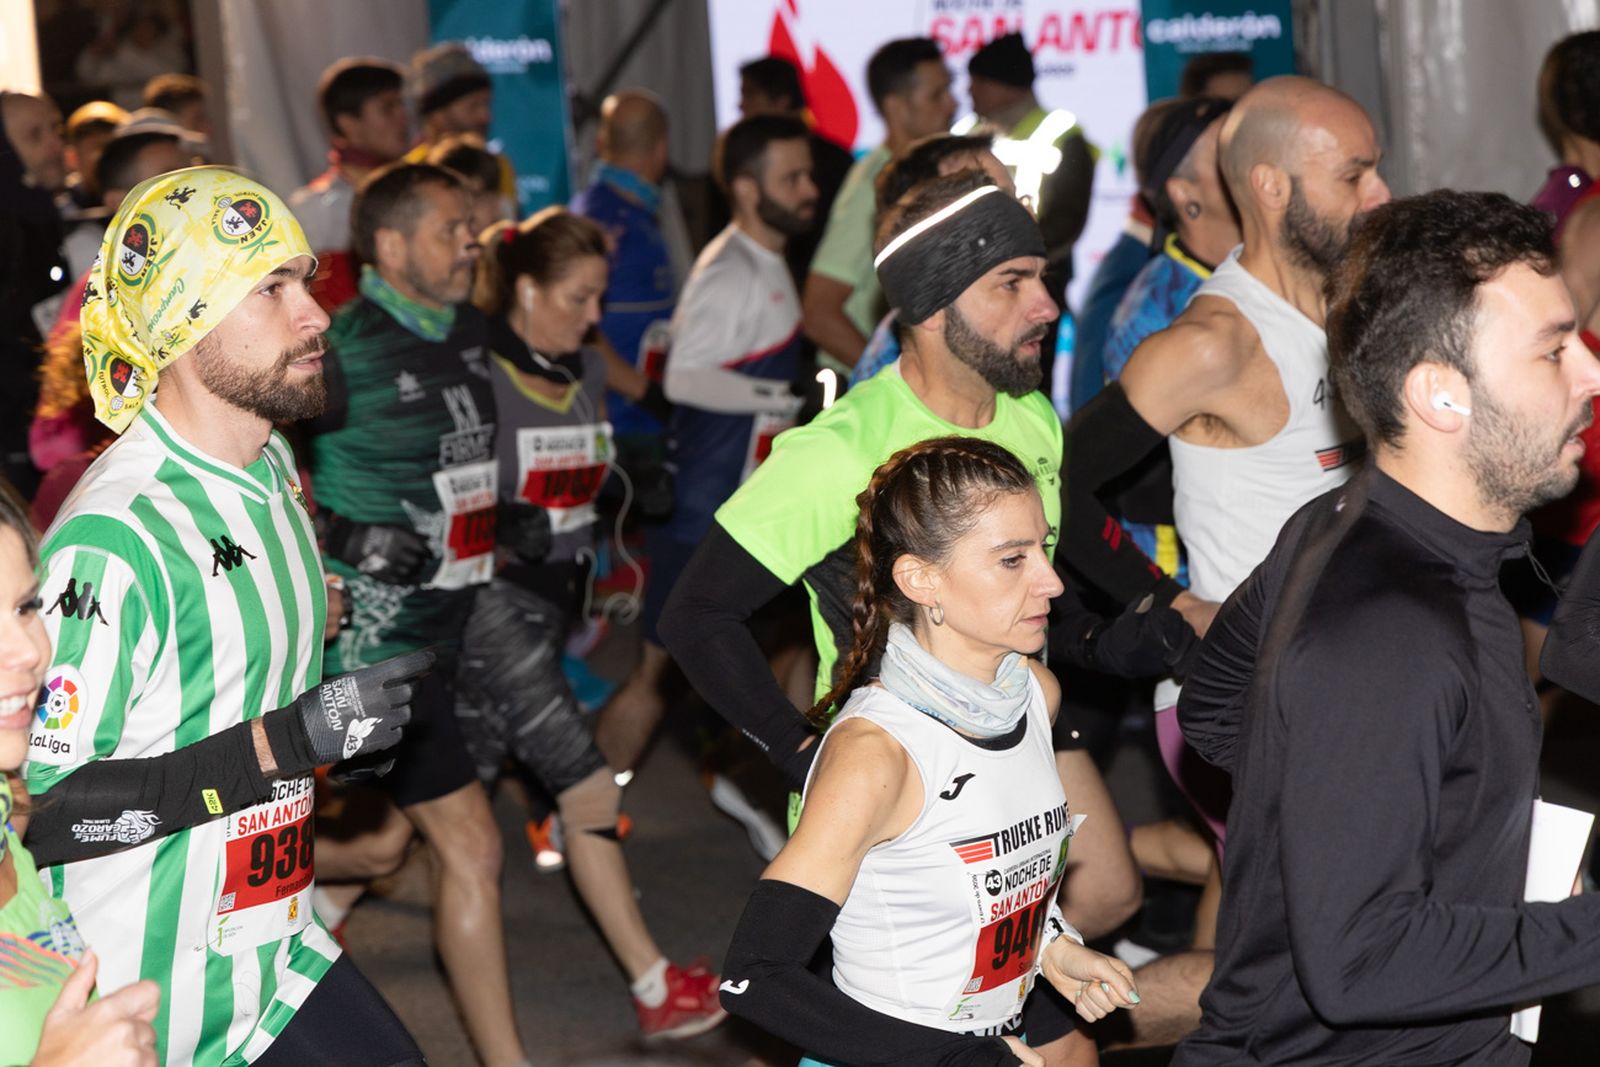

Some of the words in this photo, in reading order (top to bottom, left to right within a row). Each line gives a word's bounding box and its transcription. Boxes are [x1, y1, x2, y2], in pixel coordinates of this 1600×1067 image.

[1147, 11, 1281, 44] calderón
[322, 684, 344, 732] ANTÓN
[332, 679, 348, 709] SAN
[29, 733, 71, 754] LaLiga
[346, 734, 358, 751] 43
[238, 809, 269, 836] SAN
[992, 815, 1042, 857] TRUEKE
[247, 816, 314, 888] 938
[986, 878, 1001, 890] 43
[1004, 861, 1037, 892] NOCHE
[1039, 855, 1052, 874] DE
[991, 895, 1013, 921] SAN
